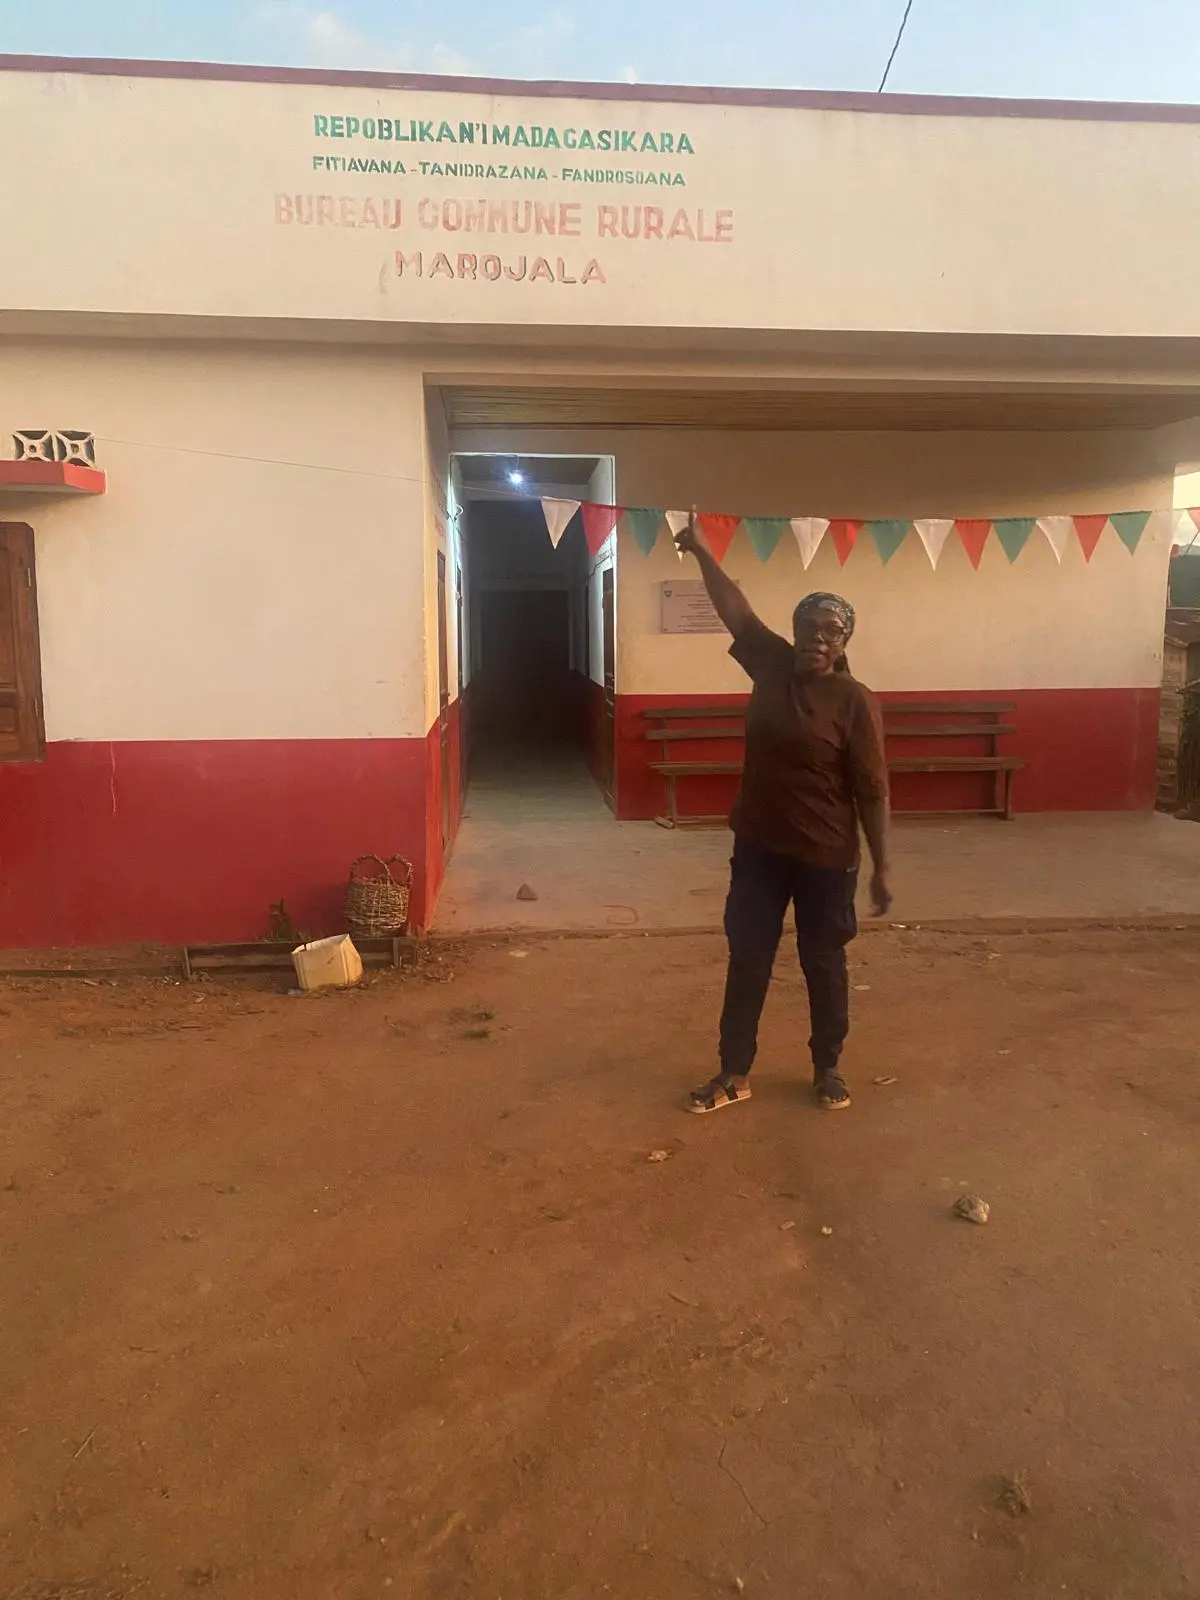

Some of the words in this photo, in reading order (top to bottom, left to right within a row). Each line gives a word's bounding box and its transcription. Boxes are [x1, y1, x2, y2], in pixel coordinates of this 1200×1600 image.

[492, 124, 695, 155] MADAGASIKARA
[312, 156, 406, 174] FITIAVANA
[274, 192, 402, 229] BUREAU
[418, 197, 581, 236] COMMUNE
[597, 204, 734, 242] RURALE
[394, 249, 607, 285] MAROJALA
